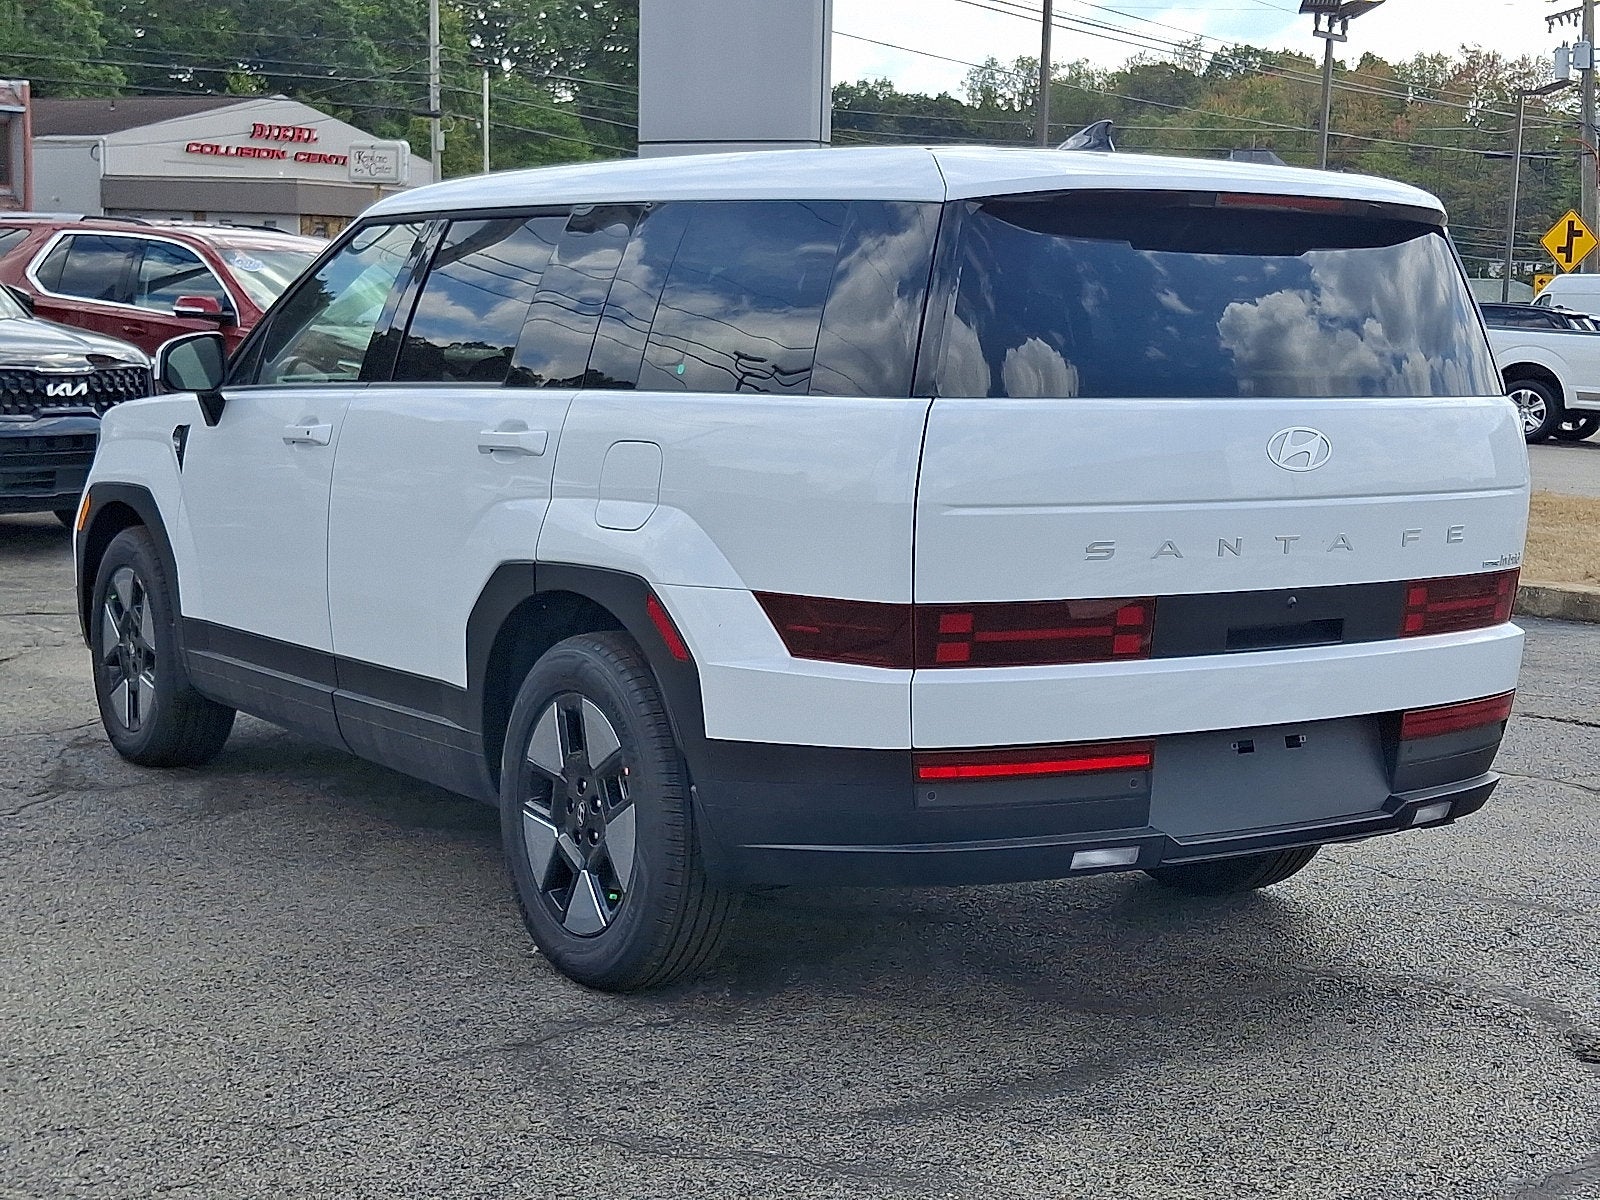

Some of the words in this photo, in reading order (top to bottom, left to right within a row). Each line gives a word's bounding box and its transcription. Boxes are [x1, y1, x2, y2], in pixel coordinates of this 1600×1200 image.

[250, 123, 319, 143] DIEHL
[186, 142, 287, 160] COLLISION
[1084, 531, 1355, 561] SANTA
[1400, 524, 1467, 548] FE
